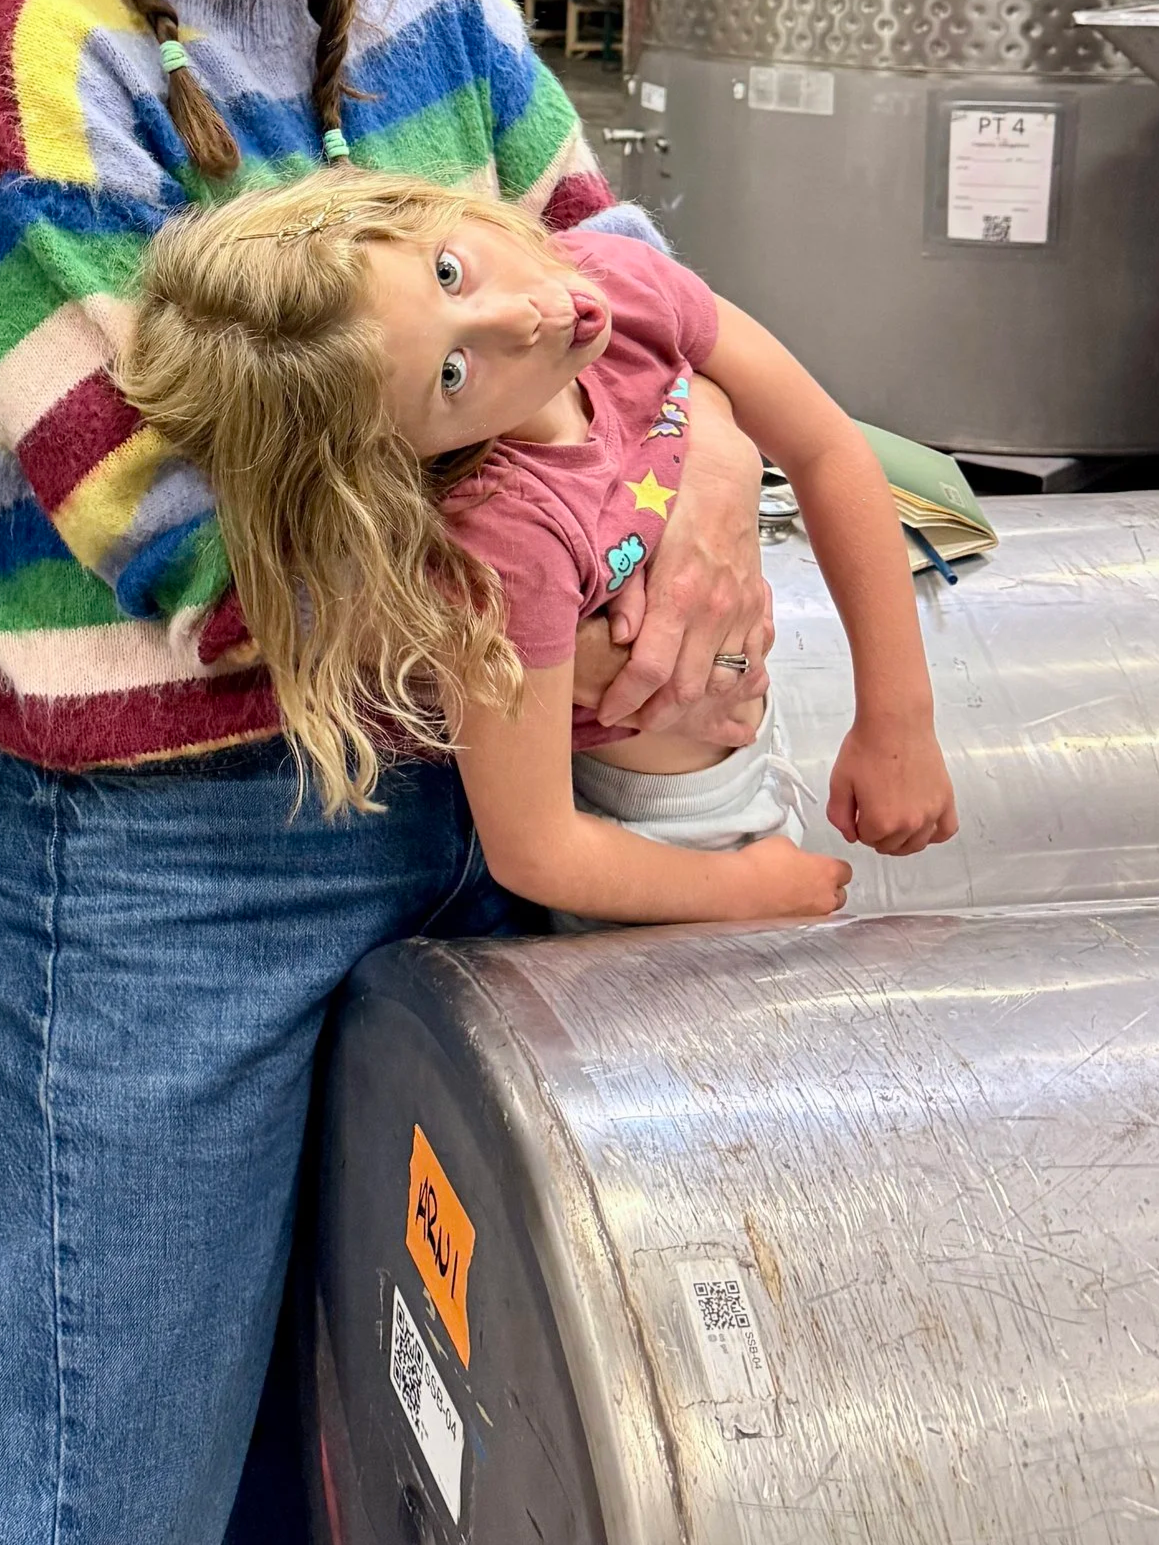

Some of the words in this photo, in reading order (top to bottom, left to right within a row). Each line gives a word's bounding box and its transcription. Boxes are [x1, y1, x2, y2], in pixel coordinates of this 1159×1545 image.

[978, 116, 1005, 135] PT
[1011, 117, 1025, 136] 4
[745, 1331, 764, 1370] SSB-04
[424, 1362, 457, 1443] SSB-04
